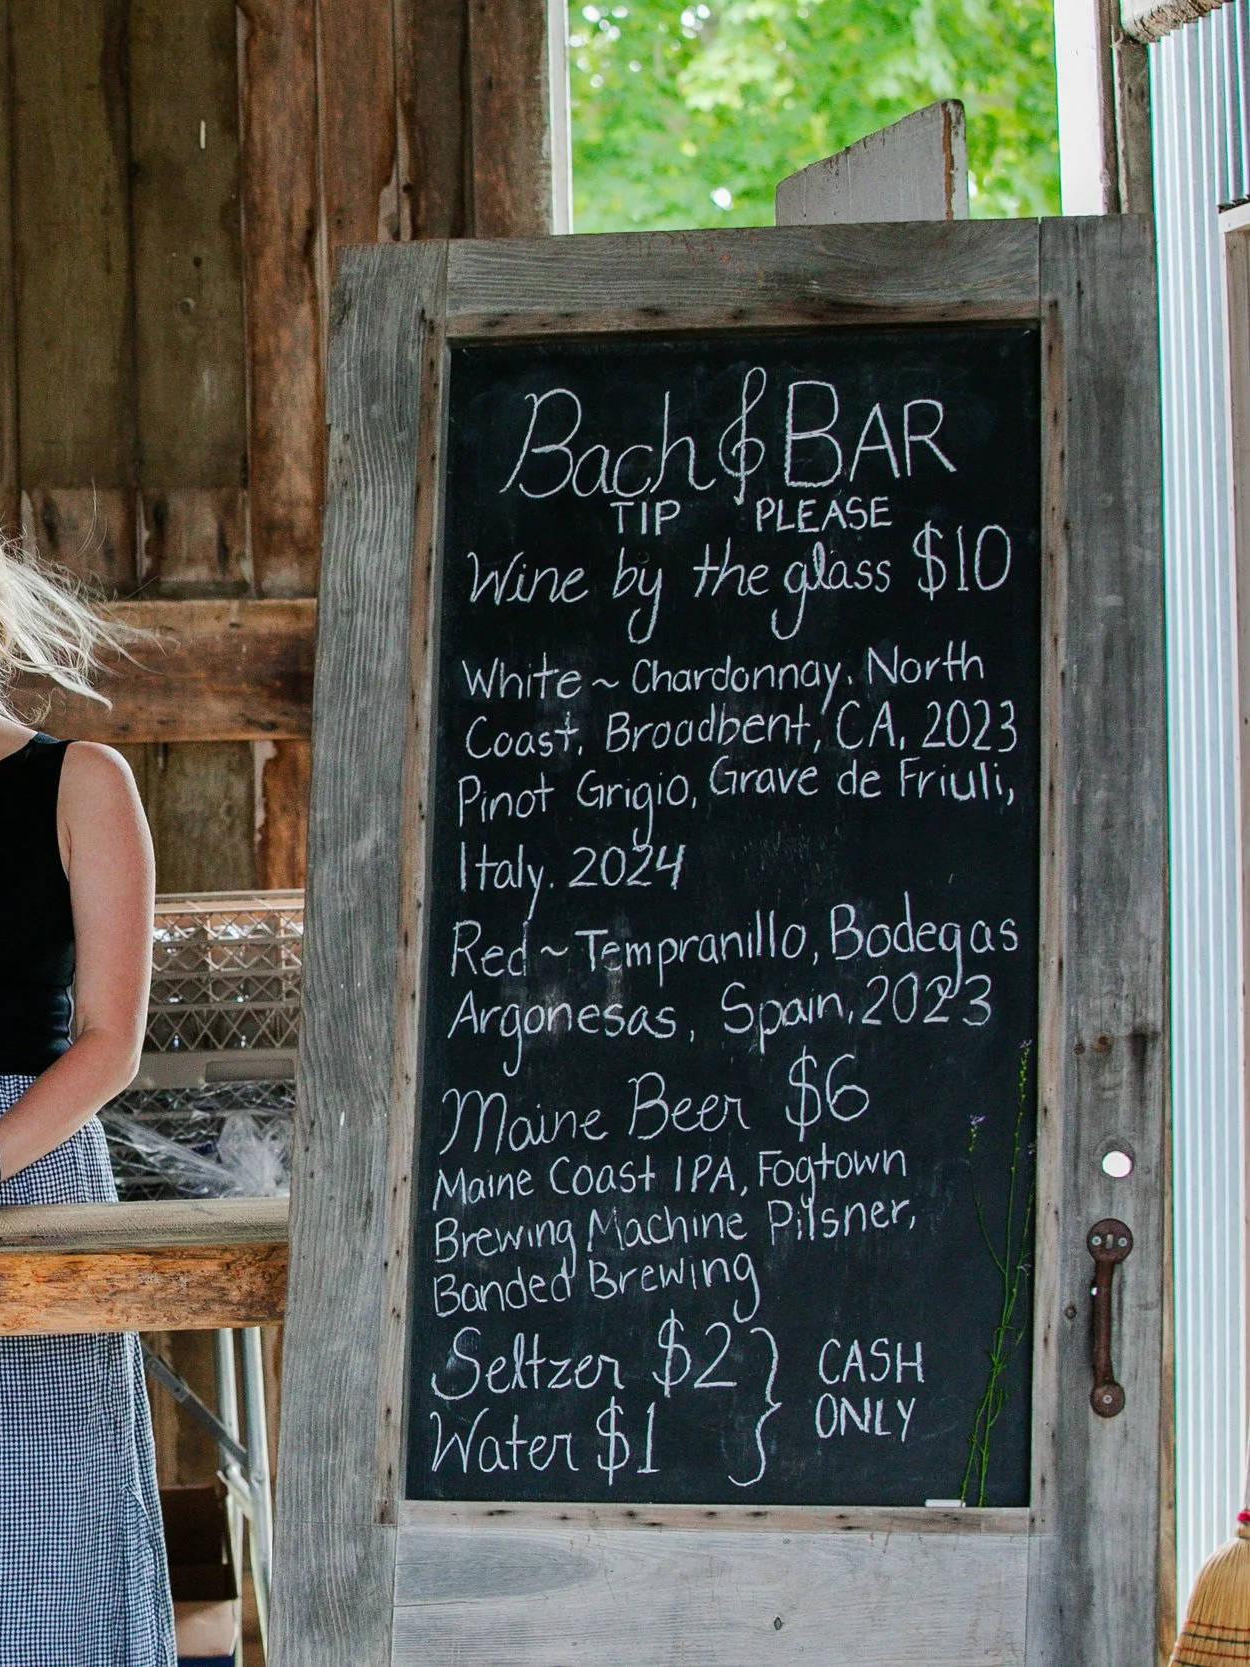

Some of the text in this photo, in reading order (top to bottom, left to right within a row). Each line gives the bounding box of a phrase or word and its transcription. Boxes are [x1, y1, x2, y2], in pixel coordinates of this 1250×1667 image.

[499, 380, 956, 499] Bach BAR
[610, 496, 893, 536] TIP PLEASE
[467, 520, 1013, 645] Wine by the glass $10
[461, 651, 582, 700] White
[868, 640, 985, 685] North
[605, 704, 822, 754] Broadbent,
[922, 699, 1018, 752] 2023
[457, 754, 1015, 851] Pinot Grigio, Grave de Friuli,
[568, 844, 687, 891] 2024
[451, 918, 528, 978] Red
[574, 908, 819, 988] Tempranillo,
[830, 890, 1019, 1000] Bodegas
[447, 990, 695, 1078] Argonesas,
[861, 971, 992, 1026] 2023
[439, 1045, 870, 1156] Maine Beer $6
[432, 1142, 908, 1212] Maine Coast IPA, Fogtown
[434, 1199, 916, 1280] Brewing Machine Pilsner,
[433, 1251, 761, 1324] Banded Brewing
[430, 1308, 738, 1402] Seltzer $2
[818, 1338, 925, 1385] CASH
[429, 1395, 662, 1487] Water $1
[814, 1393, 918, 1444] ONLY
